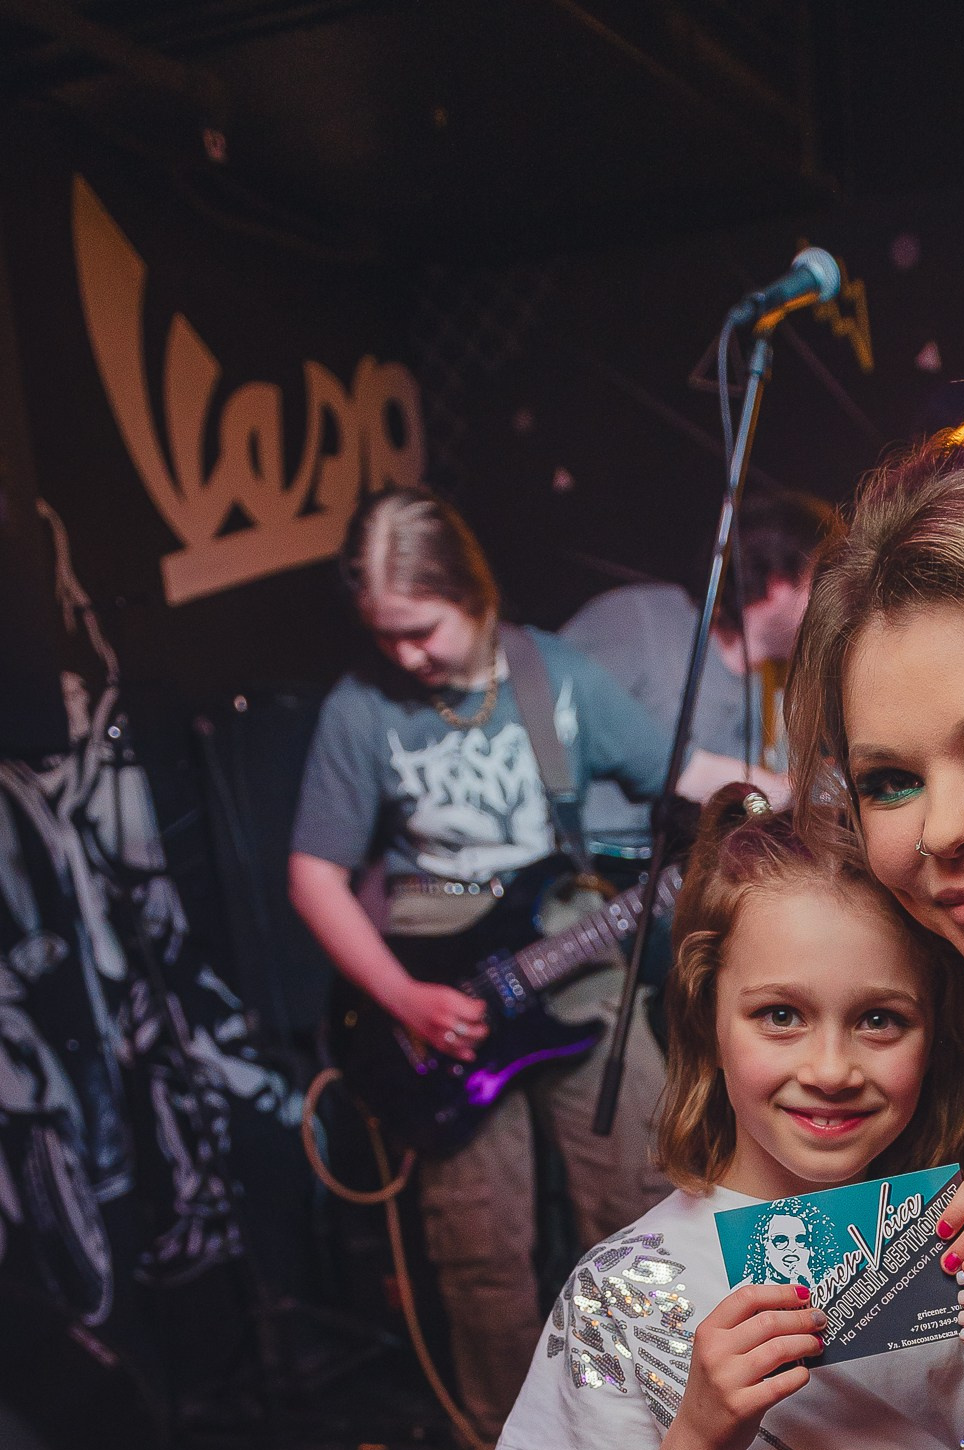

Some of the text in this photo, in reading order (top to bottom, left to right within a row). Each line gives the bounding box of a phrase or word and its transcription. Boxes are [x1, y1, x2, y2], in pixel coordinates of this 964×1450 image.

[848, 1182, 923, 1272] Voice
[822, 1264, 890, 1346] ДАРОЧНЫЙ
[839, 1329, 857, 1346] На
[854, 1303, 882, 1332] текст
[880, 1254, 932, 1306] авторской
[910, 1316, 959, 1333] +7 (917) 349-9
[887, 1341, 901, 1350] Ул.
